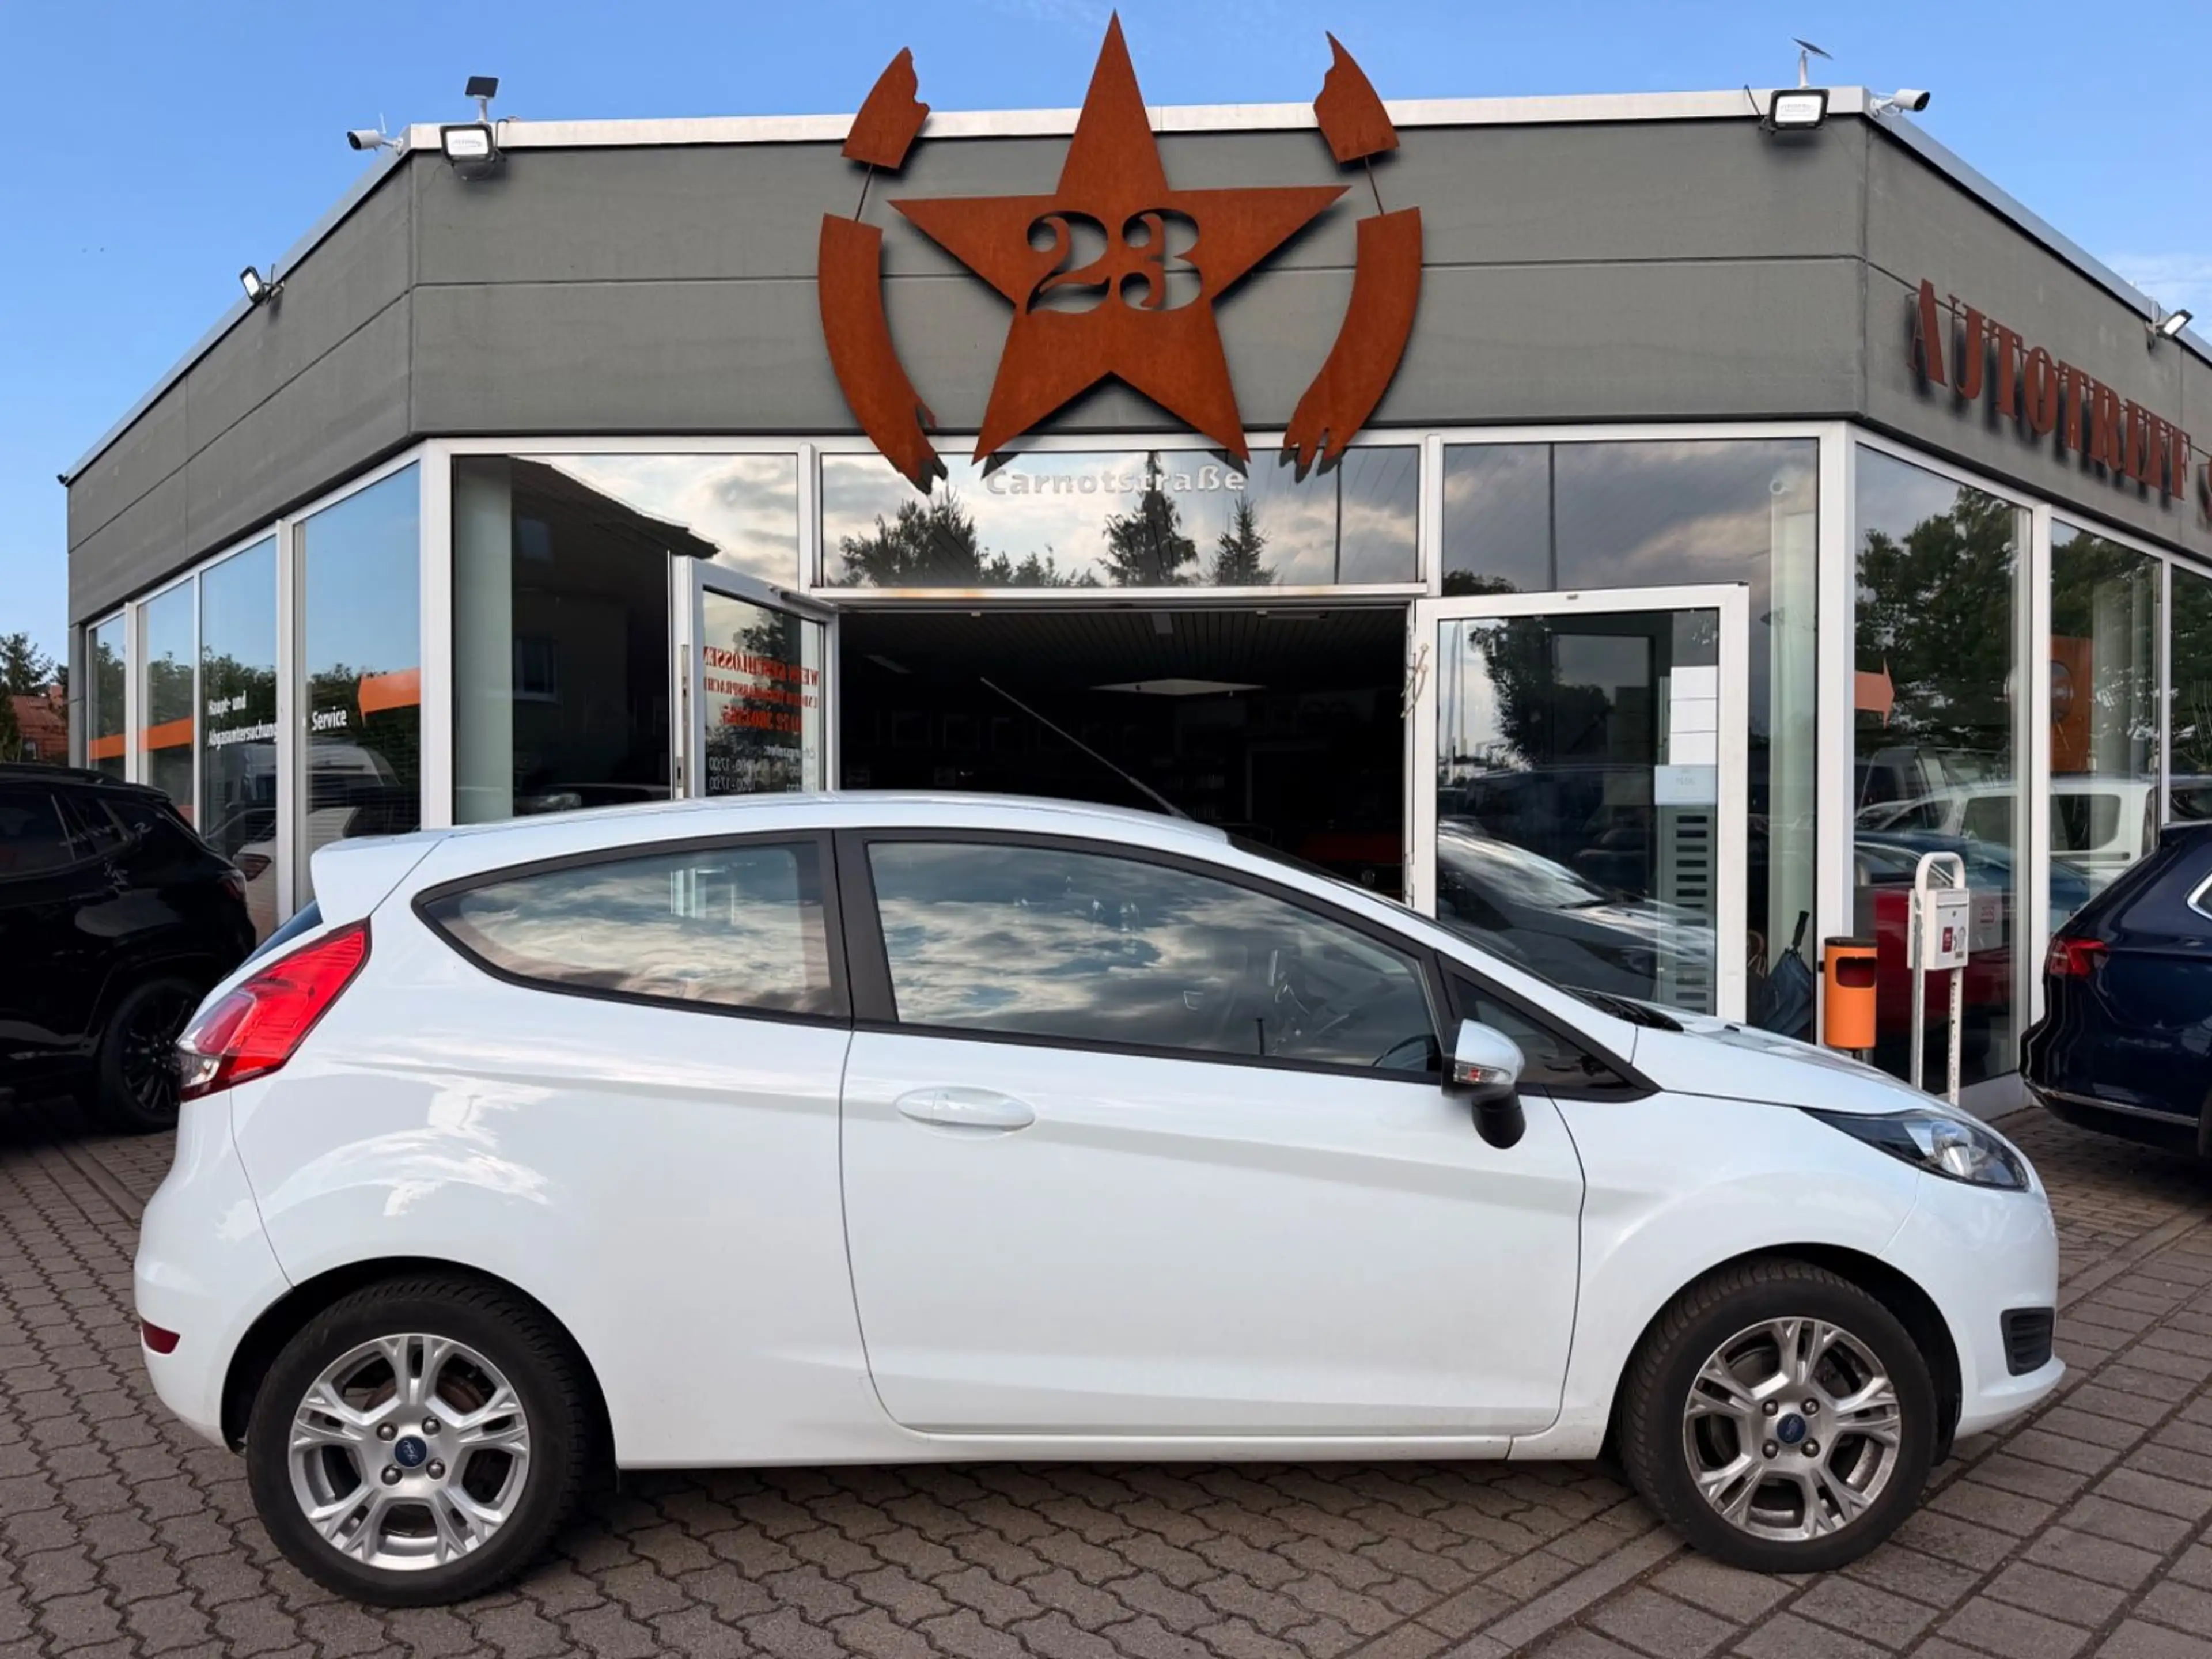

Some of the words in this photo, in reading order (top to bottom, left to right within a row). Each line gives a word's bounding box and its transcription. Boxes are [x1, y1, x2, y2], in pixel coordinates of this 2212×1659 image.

[1025, 208, 1203, 315] 23
[986, 464, 1245, 495] Carnotstraße
[232, 690, 246, 711] und
[312, 706, 347, 731] Service
